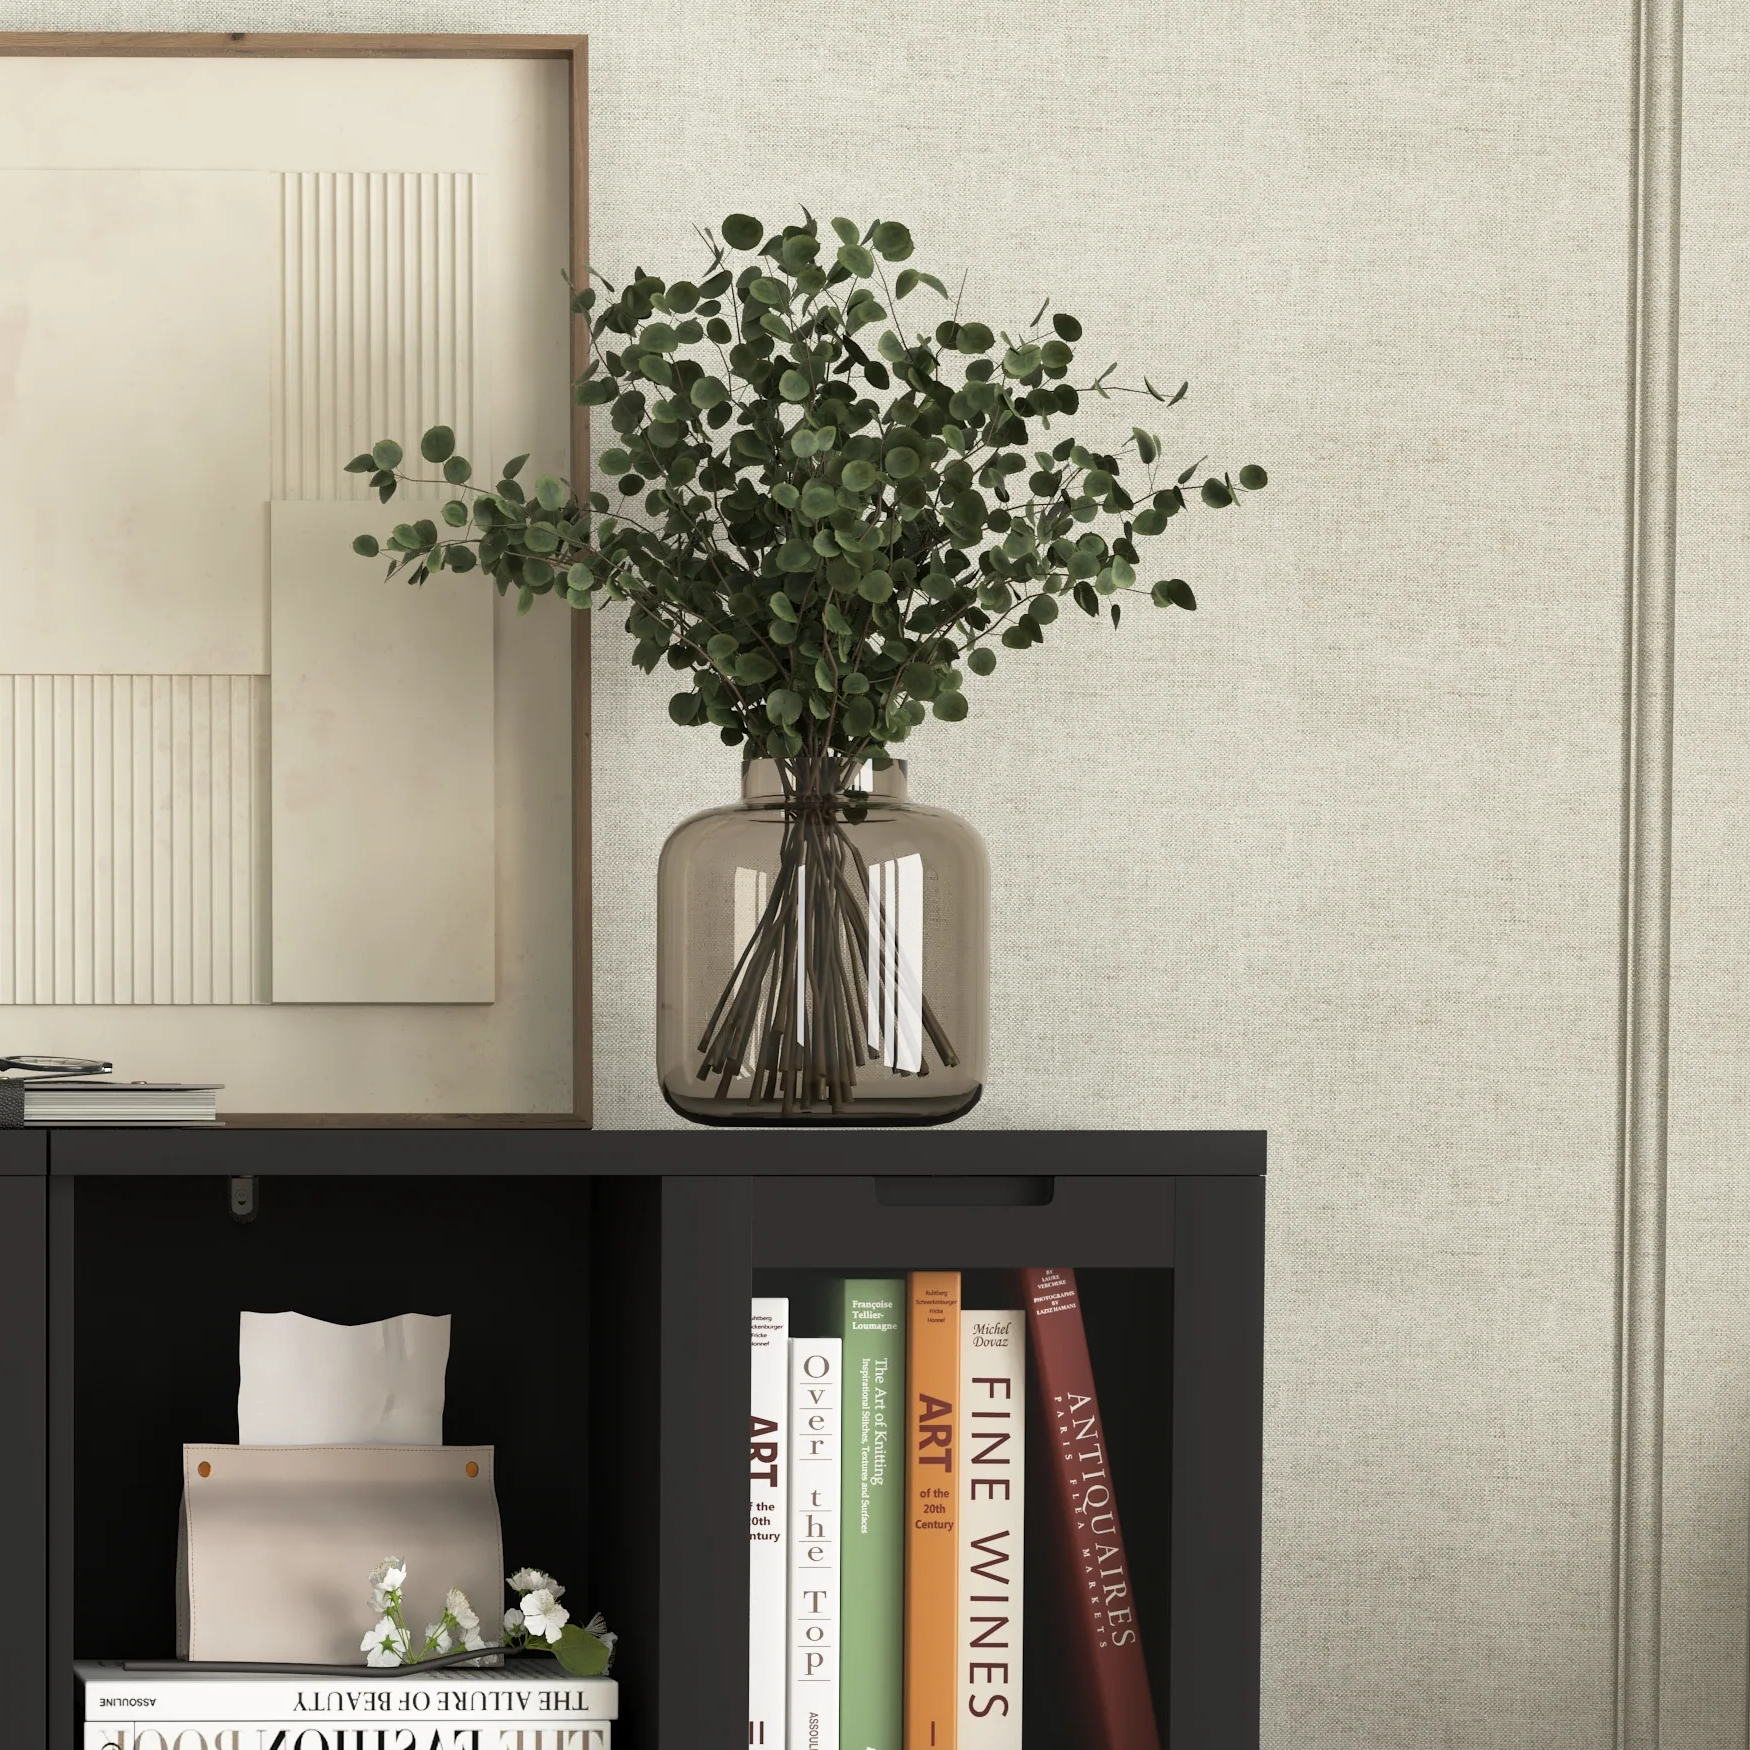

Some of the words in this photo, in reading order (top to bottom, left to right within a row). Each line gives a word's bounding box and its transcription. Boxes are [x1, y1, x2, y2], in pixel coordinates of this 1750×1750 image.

[852, 1300, 893, 1310] Françoise
[1033, 1290, 1075, 1303] PHOTOGRAPHS
[852, 1311, 885, 1319] Tellier-
[852, 1321, 898, 1332] Loumagne
[972, 1322, 1012, 1335] Michel
[972, 1336, 1009, 1347] Dovaz
[874, 1357, 888, 1384] The
[860, 1358, 870, 1409] Inspirational
[874, 1387, 887, 1410] Art
[861, 1411, 870, 1445] Stitches,
[874, 1413, 887, 1428] of
[919, 1393, 953, 1473] ART
[970, 1377, 1011, 1501] FINE
[750, 1415, 778, 1488] ART
[870, 1430, 887, 1486] Knitting
[861, 1446, 870, 1481] Textures
[861, 1482, 870, 1498] and
[920, 1488, 931, 1498] of
[933, 1488, 950, 1498] the
[756, 1502, 775, 1511] the
[861, 1499, 870, 1534] Surfaces
[923, 1504, 946, 1514] 20th
[750, 1516, 771, 1526] 0th
[915, 1519, 954, 1531] Century
[1054, 1396, 1073, 1460] PARIS
[1069, 1479, 1085, 1529] FLEA
[1082, 1548, 1107, 1648] MARKETS
[1067, 1392, 1136, 1647] ANTIQUAIRES
[750, 1532, 781, 1543] ntury
[968, 1530, 1010, 1718] WINES
[100, 1698, 156, 1707] ASSOULINE
[293, 1690, 391, 1712] BEAUTY
[399, 1690, 431, 1712] OF
[437, 1690, 532, 1711] ALLURE
[539, 1690, 589, 1711] THE
